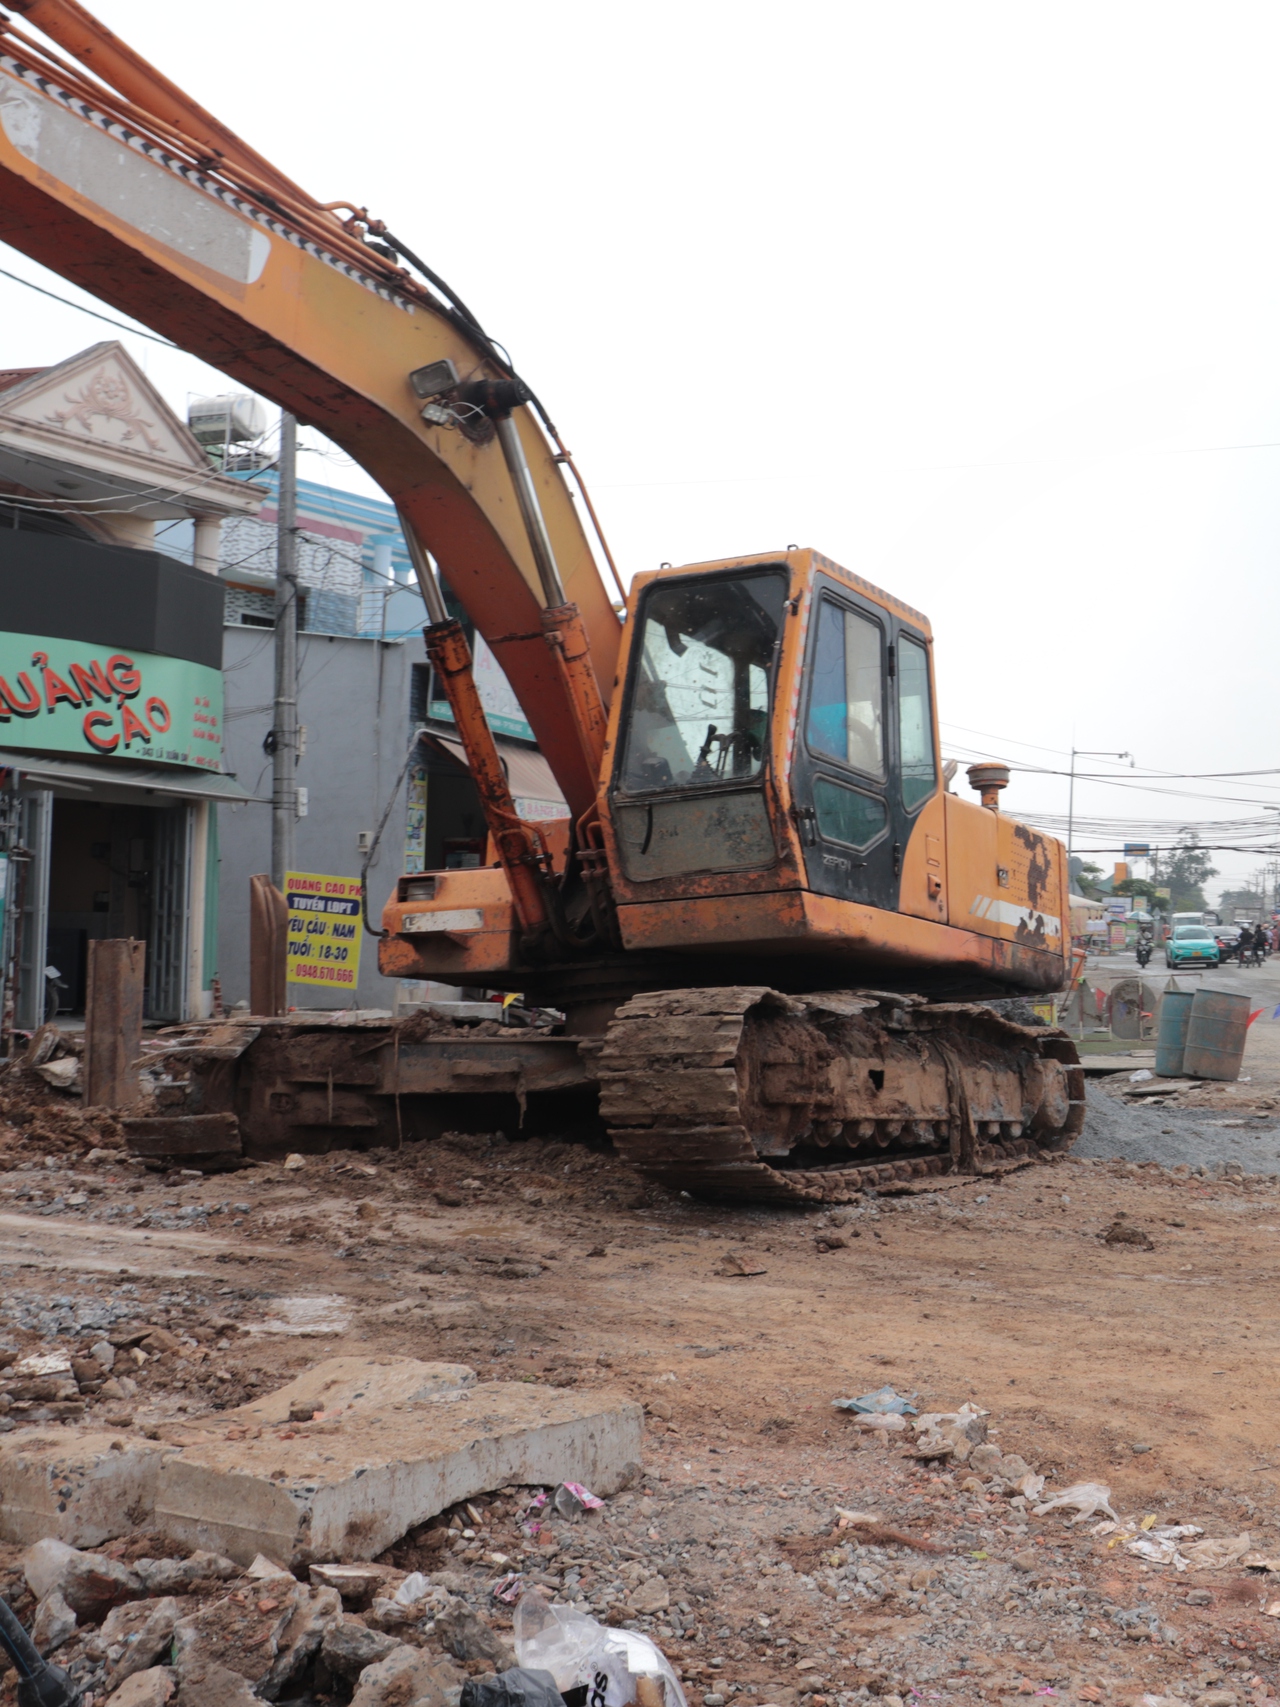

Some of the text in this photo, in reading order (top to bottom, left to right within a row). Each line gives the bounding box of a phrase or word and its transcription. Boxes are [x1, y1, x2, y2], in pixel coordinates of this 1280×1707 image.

[83, 694, 171, 753] CÁO
[325, 880, 346, 895] CÁO
[332, 923, 356, 938] NAM
[318, 945, 348, 961] 18-30
